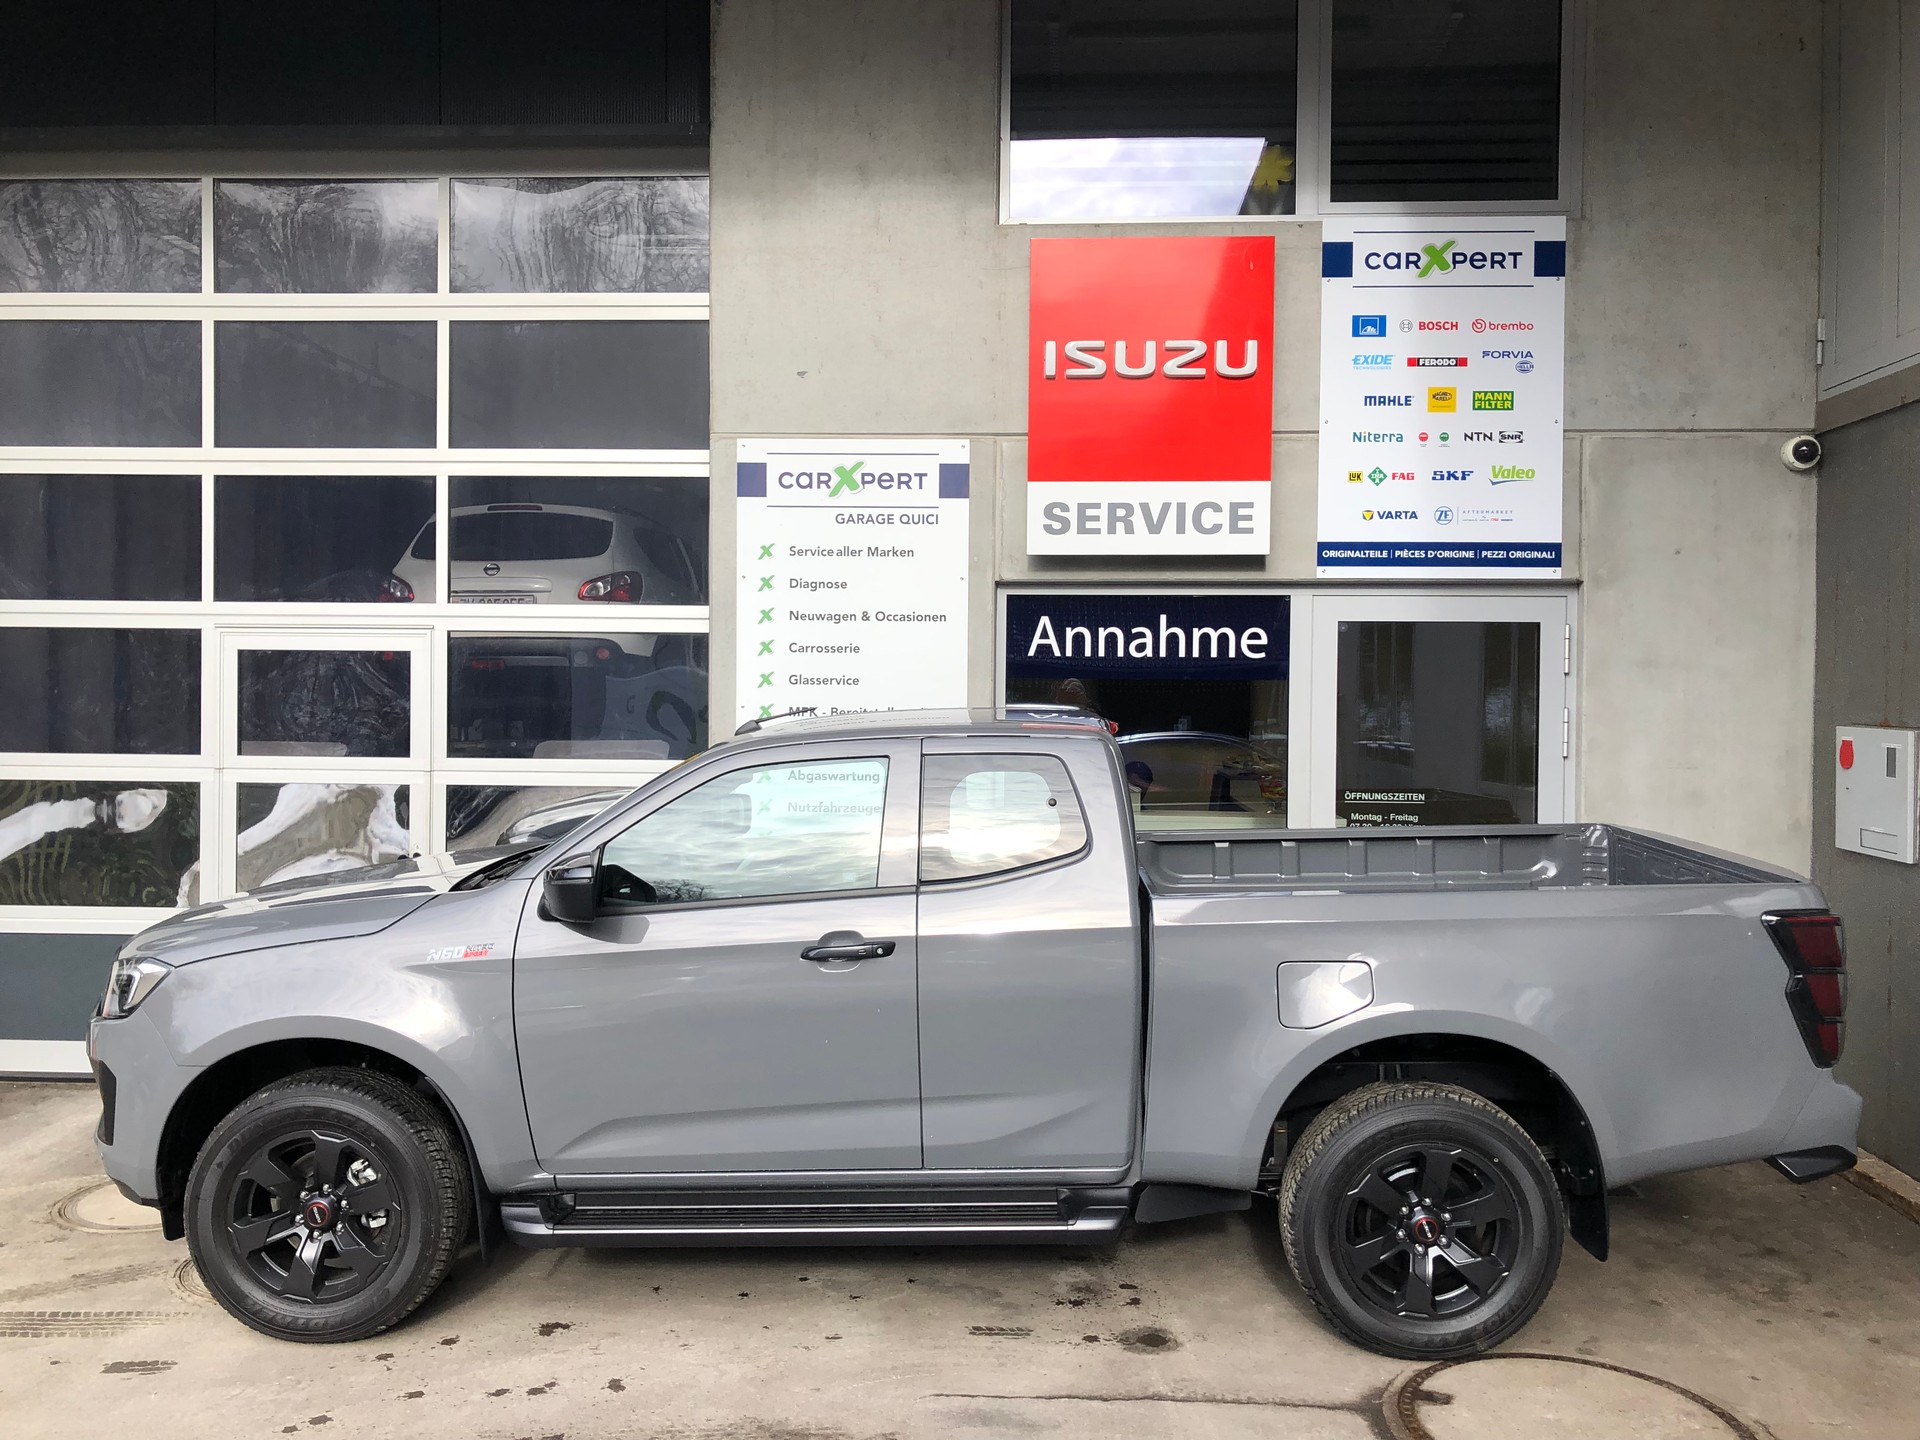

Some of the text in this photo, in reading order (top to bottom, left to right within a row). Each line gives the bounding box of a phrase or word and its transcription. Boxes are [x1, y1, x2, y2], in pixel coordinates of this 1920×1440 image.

[1418, 321, 1459, 331] BOSCH
[1488, 321, 1534, 331] brembo
[1044, 339, 1259, 379] ISUZU
[1352, 354, 1394, 365] EXIDE
[1482, 350, 1534, 359] FORVIA
[1419, 358, 1457, 366] FERODO
[1364, 395, 1412, 407] MAHLE
[1474, 392, 1512, 400] MANN
[1474, 400, 1512, 409] FILTER
[1352, 431, 1404, 443] Niterra
[1464, 432, 1493, 442] NTN
[1499, 432, 1522, 442] SNR
[1391, 472, 1415, 481] FAG
[1431, 470, 1474, 481] SKF
[1491, 465, 1536, 480] Valeo
[835, 513, 939, 525] GARAGE QUICI
[1042, 501, 1255, 536] SERVICE
[1377, 510, 1418, 520] VARTA
[789, 546, 914, 558] Service aller Marken
[1322, 550, 1388, 559] ORIGINALTEILE
[1395, 548, 1426, 559] PIÈCES
[1481, 550, 1507, 559] PEZZI
[1508, 550, 1556, 560] ORIGINALI
[789, 578, 848, 592] Diagnose
[789, 611, 947, 624] Neuwagen & Occasionen
[1027, 614, 1269, 659] Annahme
[788, 642, 861, 654] Carrosserie
[788, 674, 860, 686] Glasservice
[787, 769, 881, 785] Abgaswartung
[1344, 790, 1426, 801] ÖFFNUNGSZEITEN
[787, 801, 882, 816] Nutzfahrzeuge
[1350, 812, 1383, 823] Montag
[1389, 813, 1419, 823] Freitag
[426, 945, 466, 962] N60
